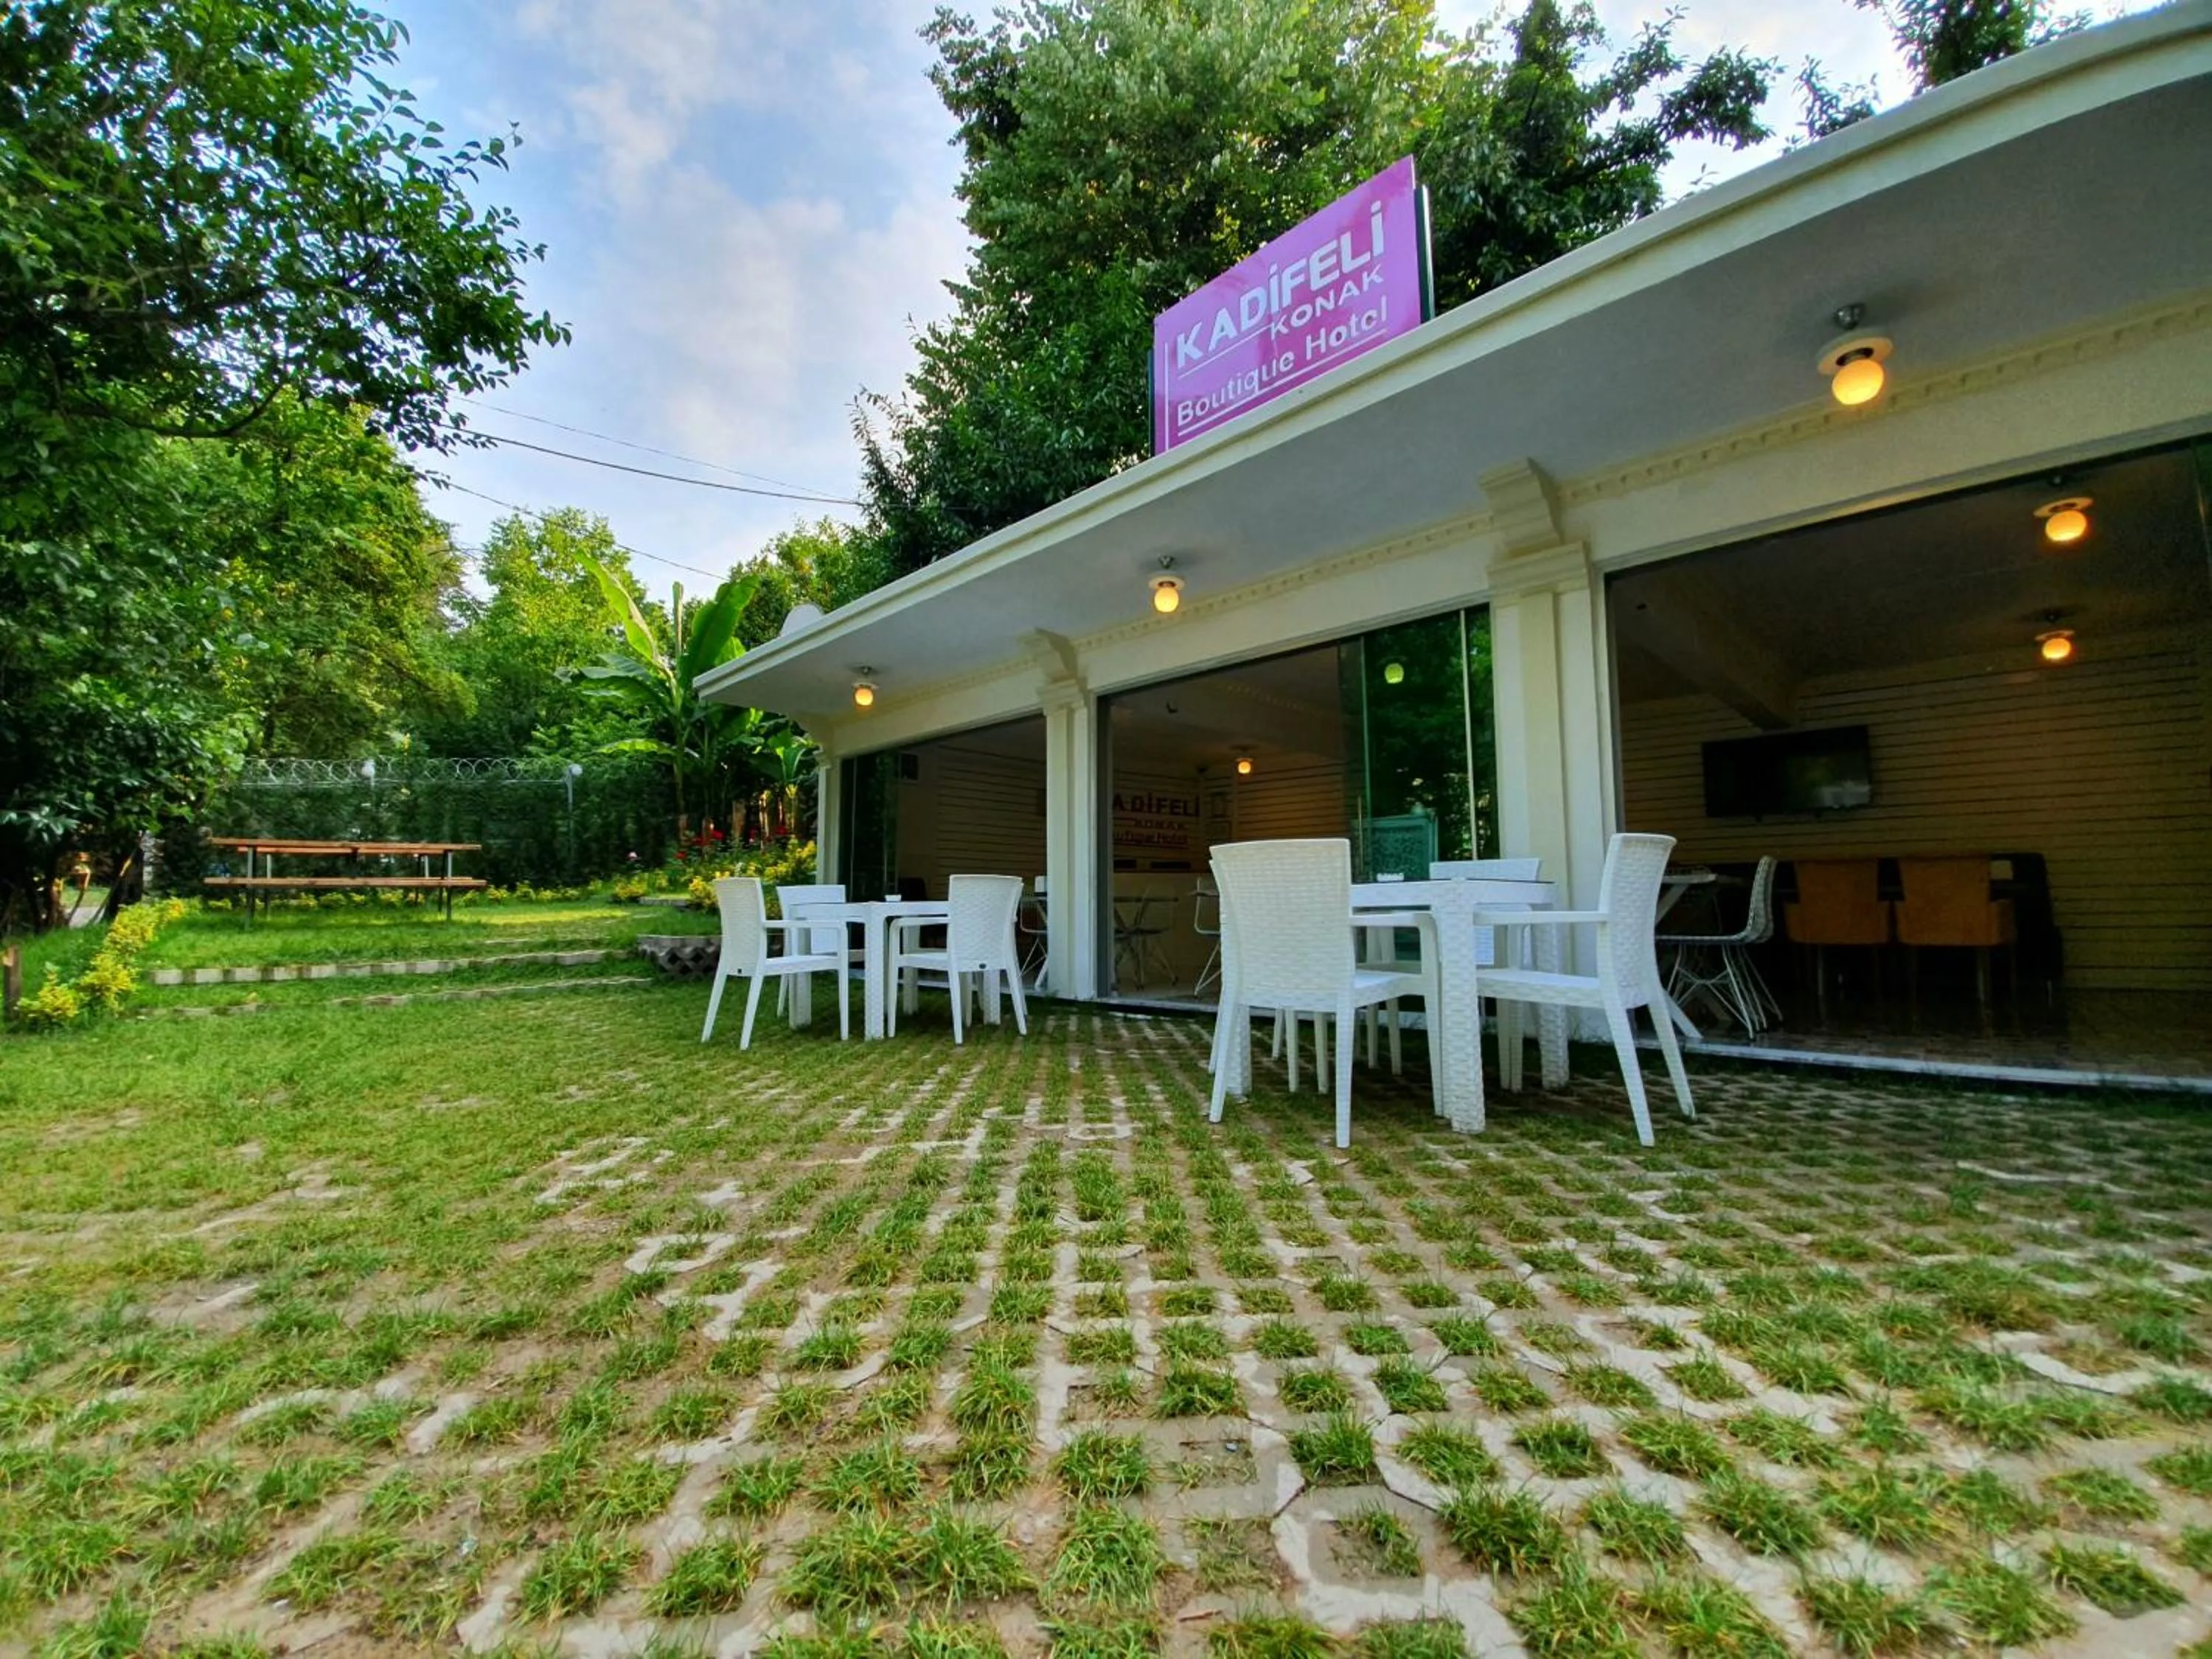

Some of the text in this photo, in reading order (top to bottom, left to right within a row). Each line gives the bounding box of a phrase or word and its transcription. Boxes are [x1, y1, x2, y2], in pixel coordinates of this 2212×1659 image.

[1178, 200, 1385, 368] KADİFELİ
[1270, 264, 1384, 341] KONAK
[1178, 296, 1387, 426] Boutique Hotel
[1113, 792, 1200, 817] ADİFELİ
